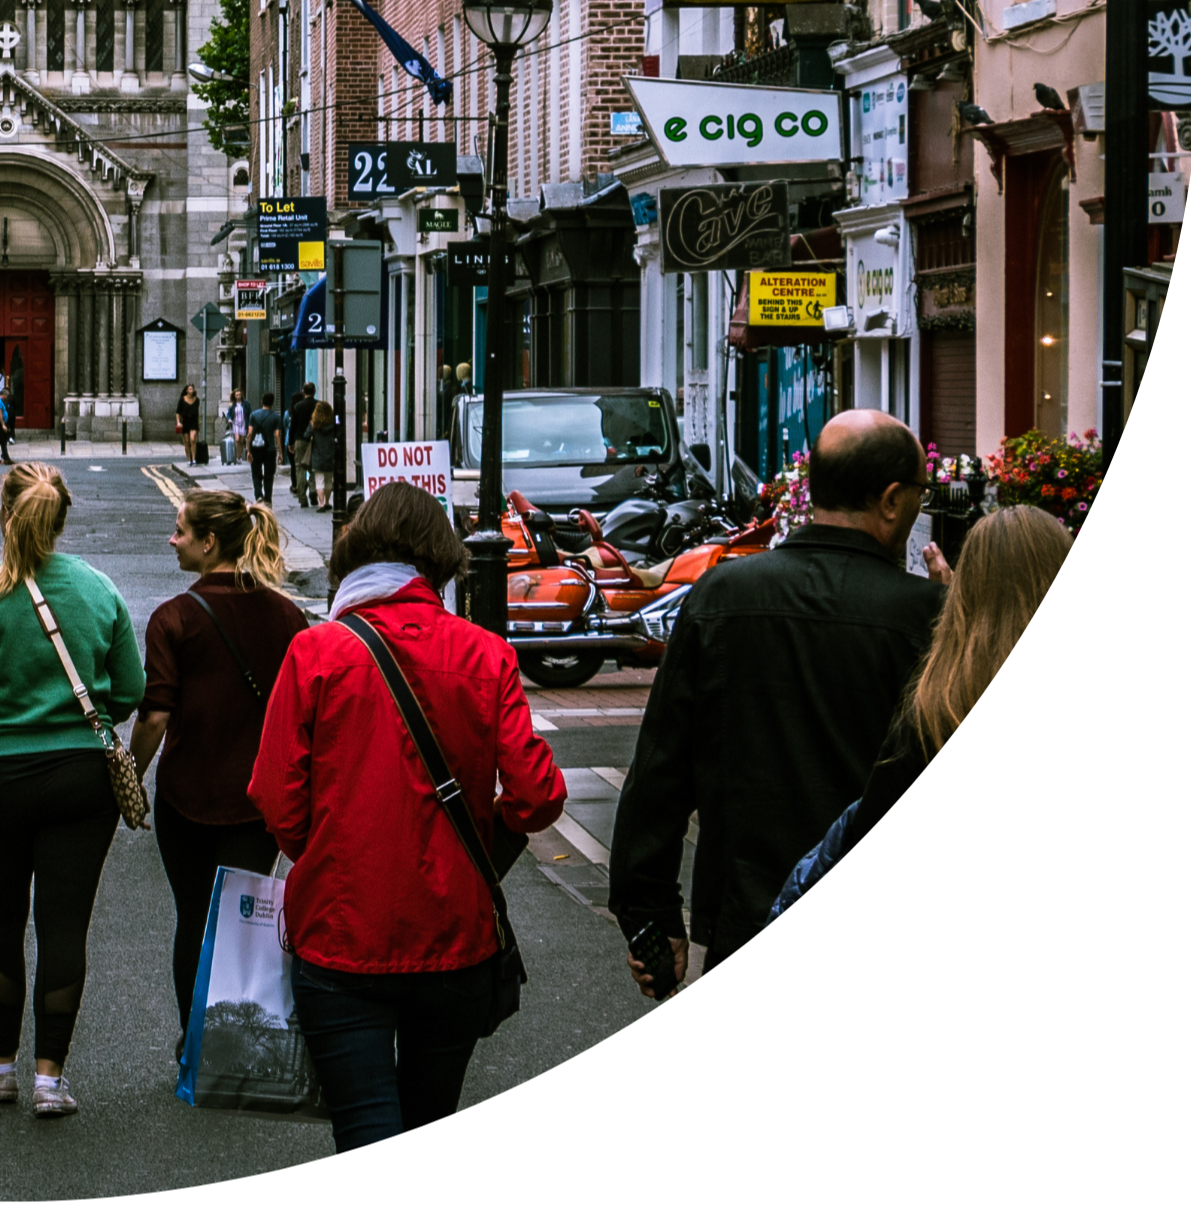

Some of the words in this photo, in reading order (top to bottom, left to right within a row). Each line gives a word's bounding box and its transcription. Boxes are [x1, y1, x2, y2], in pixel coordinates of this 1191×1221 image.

[664, 116, 688, 143] e
[699, 113, 763, 148] cig
[774, 110, 828, 138] co
[1148, 185, 1172, 197] amh
[260, 202, 273, 213] To
[276, 202, 295, 212] Let
[749, 251, 782, 264] BAR
[300, 259, 323, 268] savills
[760, 278, 826, 286] ALTERATION
[772, 288, 815, 297] CENTRE
[378, 448, 398, 468] DO
[403, 446, 433, 466] NOT
[412, 474, 446, 495] THIS
[255, 897, 274, 906] Trinity
[255, 904, 275, 913] College
[255, 911, 274, 919] Dublin
